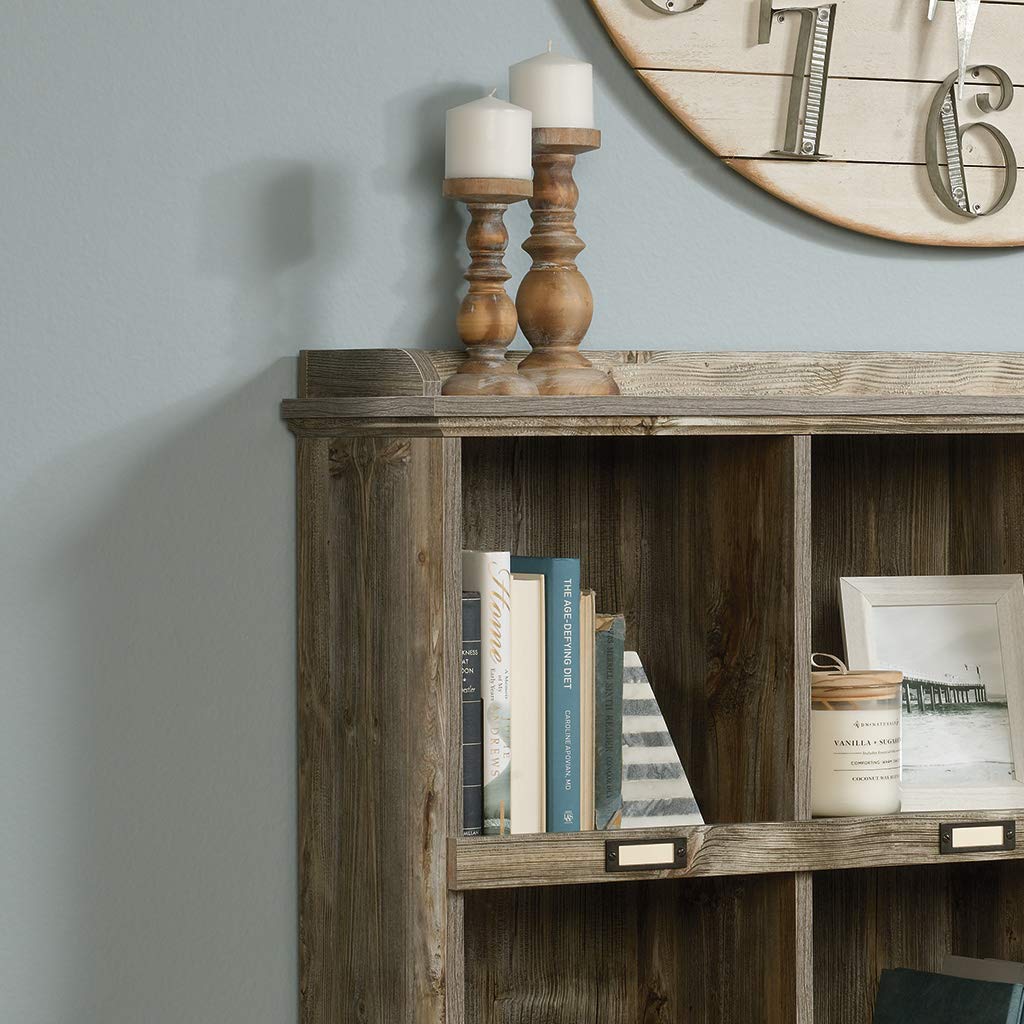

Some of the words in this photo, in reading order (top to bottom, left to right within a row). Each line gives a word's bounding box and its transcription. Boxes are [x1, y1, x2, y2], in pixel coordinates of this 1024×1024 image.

[757, 2, 836, 160] 7
[924, 62, 1018, 218] 6
[563, 578, 572, 598] THE
[563, 599, 572, 665] AGE-DEFYING
[563, 667, 572, 689] DIET
[564, 710, 572, 744] CAROLINE
[564, 779, 572, 791] MD
